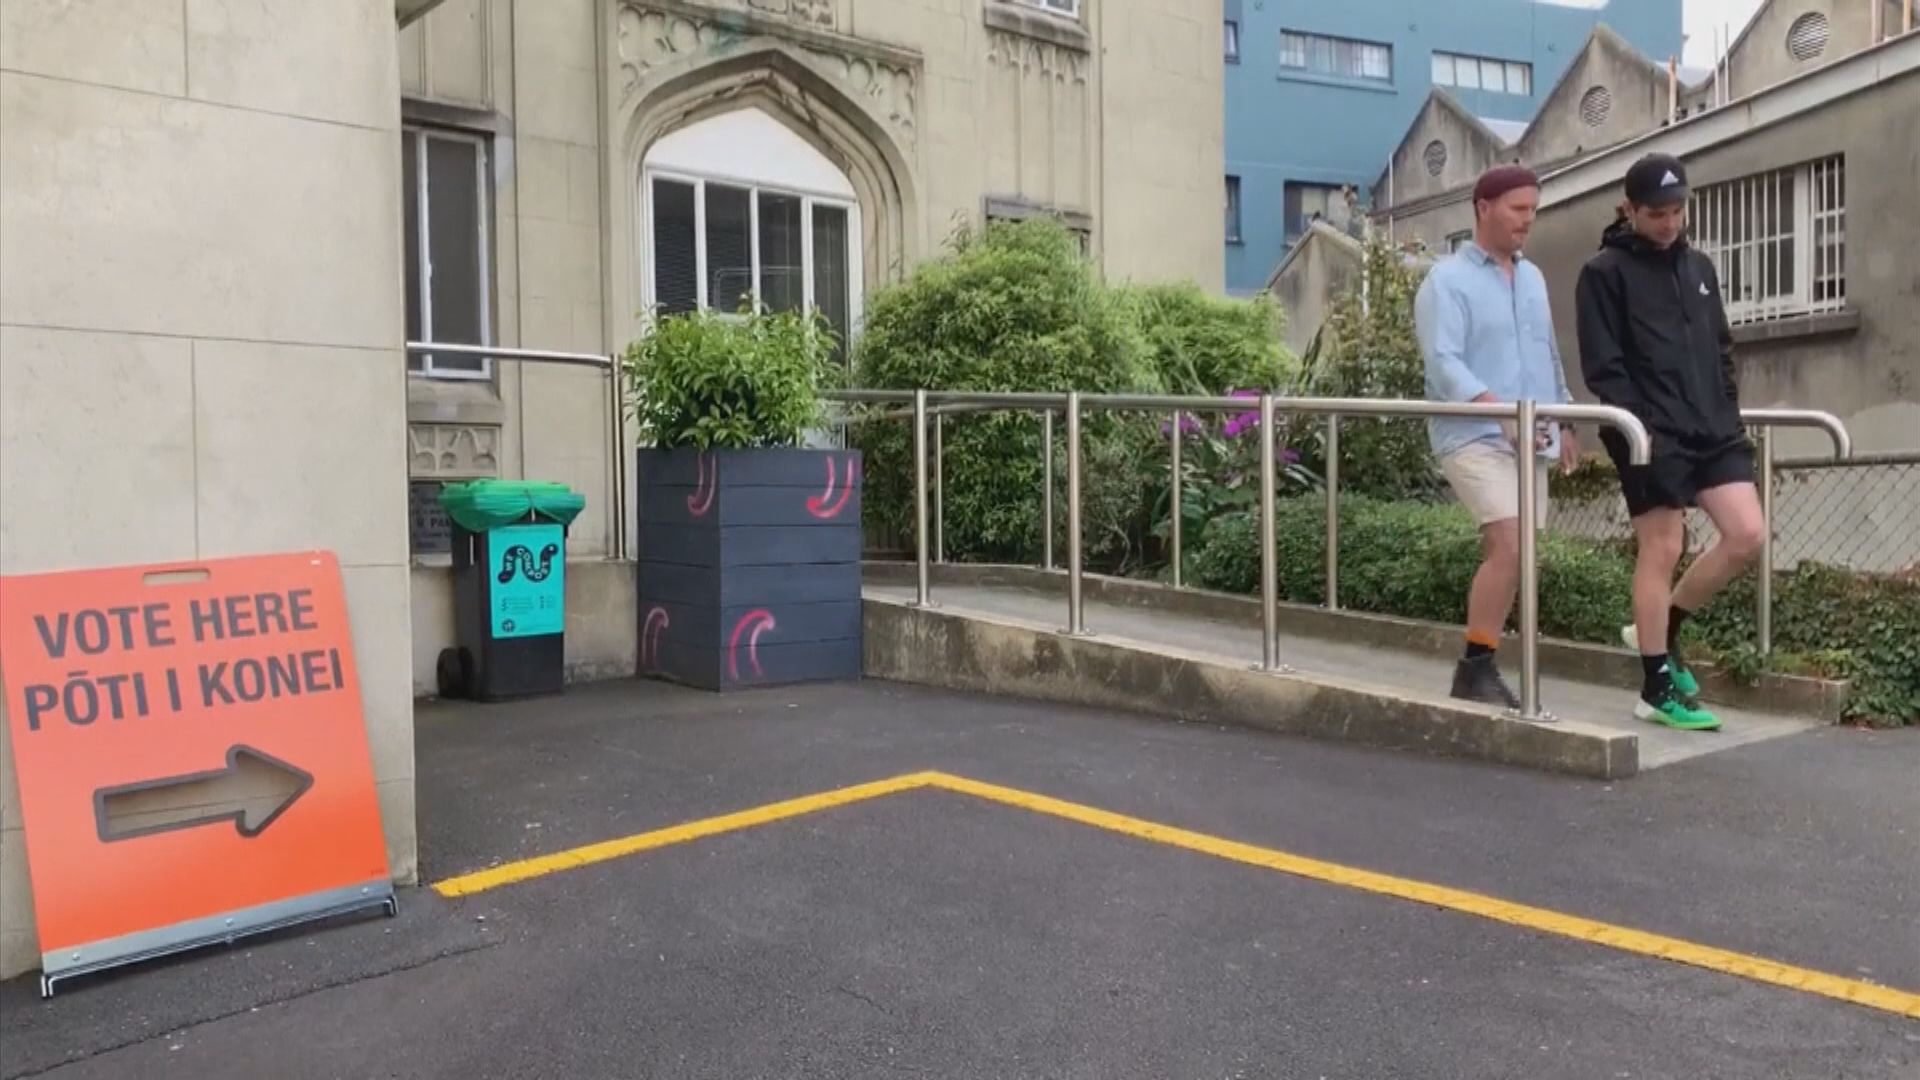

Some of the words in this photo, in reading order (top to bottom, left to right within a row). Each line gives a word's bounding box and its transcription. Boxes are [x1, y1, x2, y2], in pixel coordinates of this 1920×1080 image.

[34, 602, 175, 659] VOTE
[189, 588, 319, 643] HERE
[23, 670, 149, 731] PŌTI
[167, 667, 183, 711] I
[199, 647, 345, 708] KONEI
